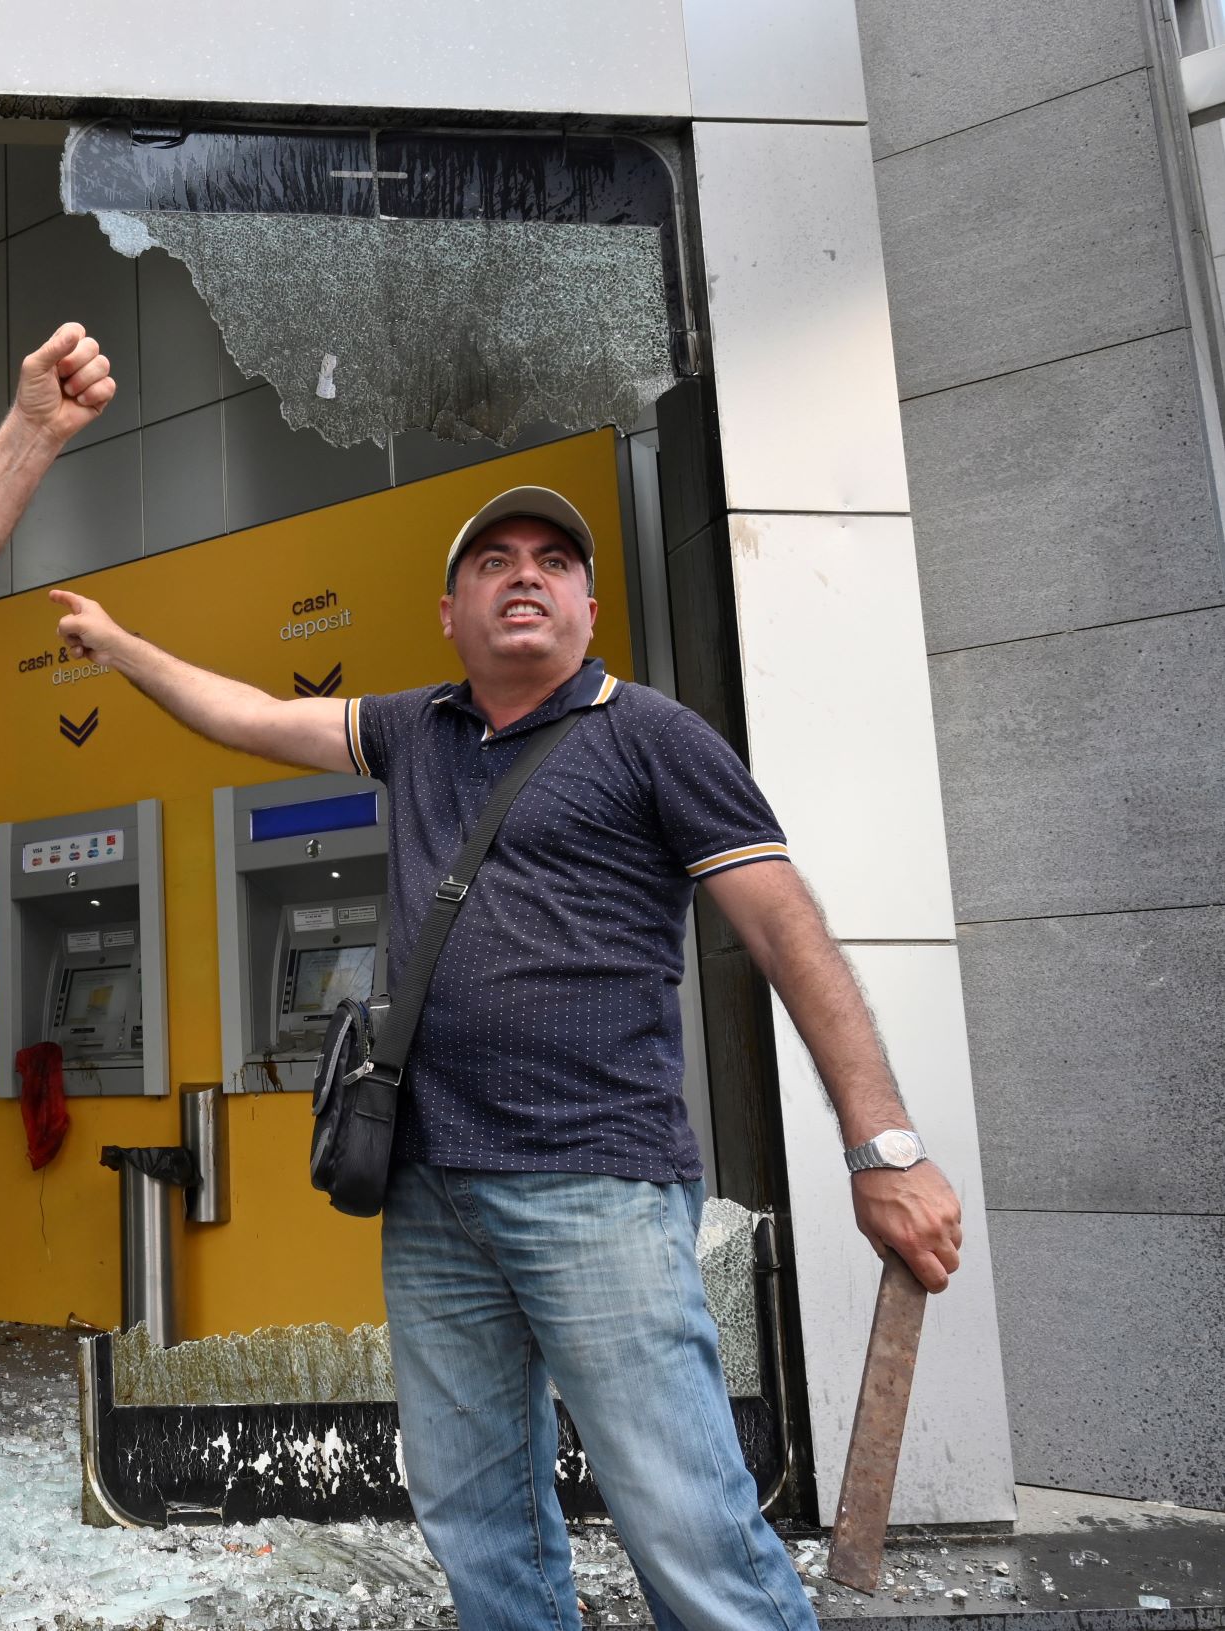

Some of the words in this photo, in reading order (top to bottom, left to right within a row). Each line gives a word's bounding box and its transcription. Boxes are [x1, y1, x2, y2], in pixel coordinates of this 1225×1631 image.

[292, 589, 338, 615] cash
[280, 608, 351, 641] deposit
[18, 650, 54, 673] cash
[58, 647, 69, 663] &
